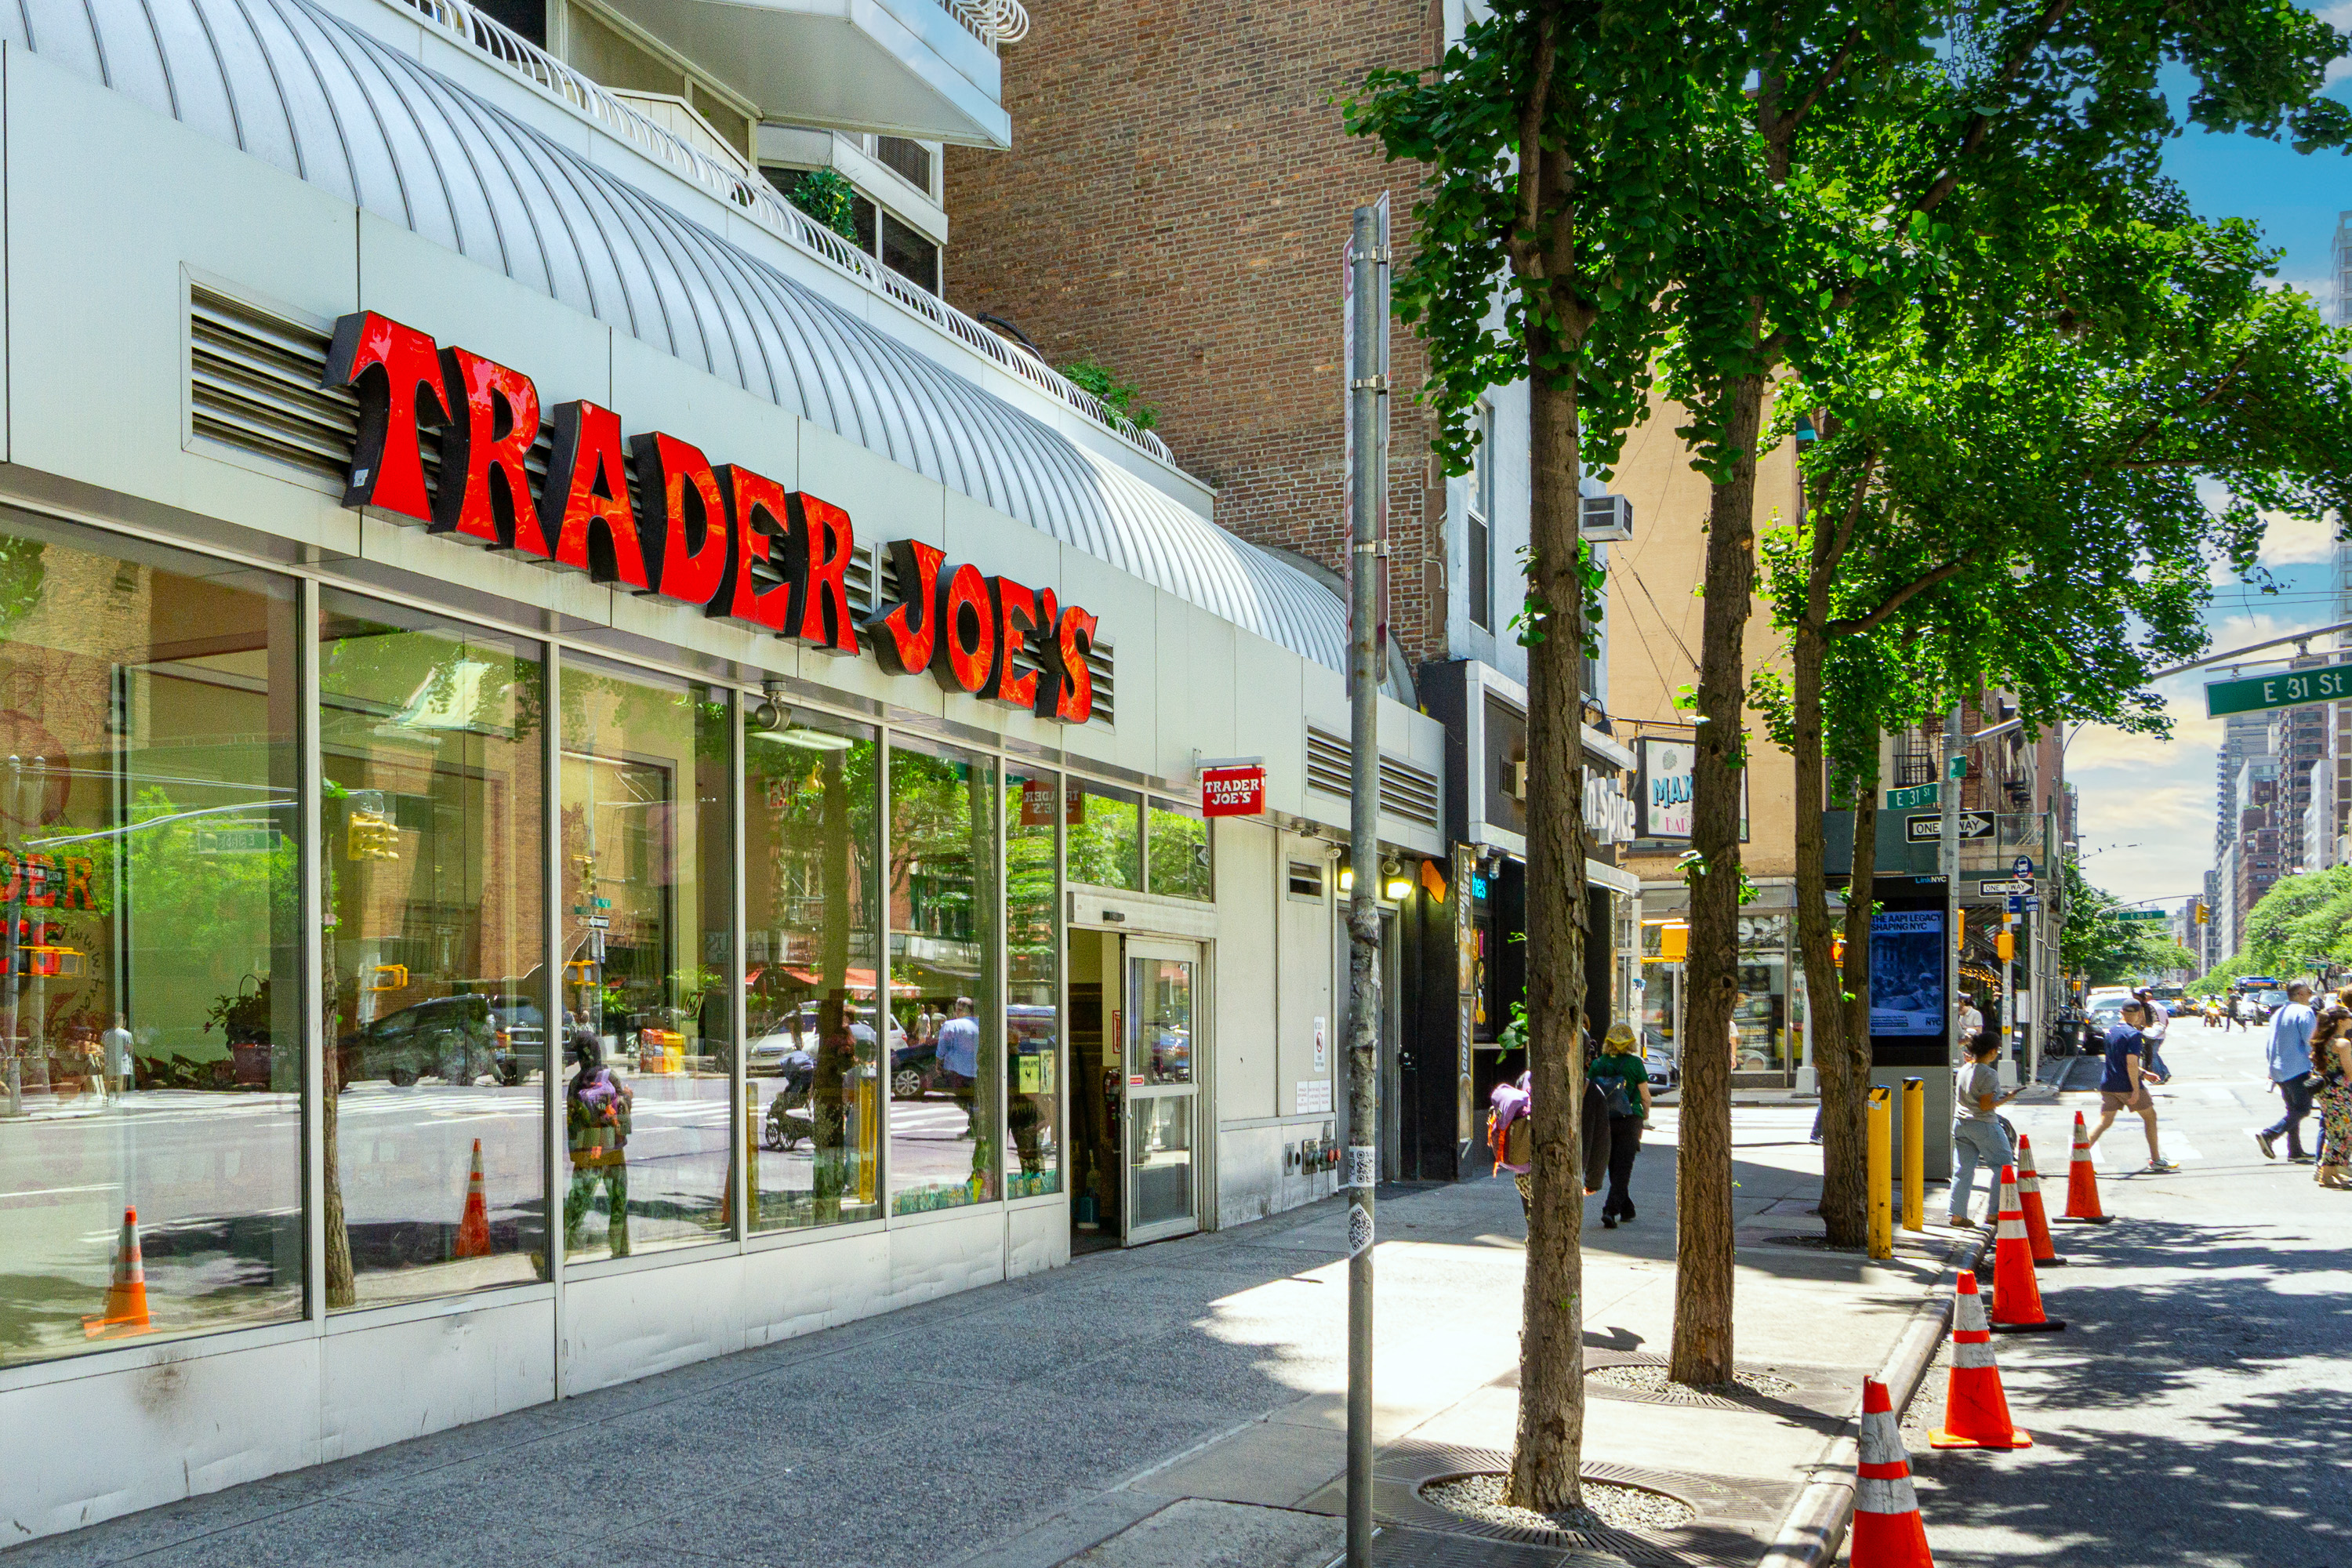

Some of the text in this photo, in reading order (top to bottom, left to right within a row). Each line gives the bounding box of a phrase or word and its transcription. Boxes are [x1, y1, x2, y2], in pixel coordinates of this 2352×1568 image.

[337, 310, 1098, 724] TRADER JOE'S
[2263, 673, 2343, 702] E 31 St
[1205, 779, 1259, 793] TRADER
[1211, 791, 1252, 805] JOE'S
[1896, 787, 1930, 806] E 31 St
[1916, 824, 1940, 833] ONE
[1872, 913, 1941, 923] THE AAPI LEGACY
[1871, 922, 1927, 931] SHAPING NYC
